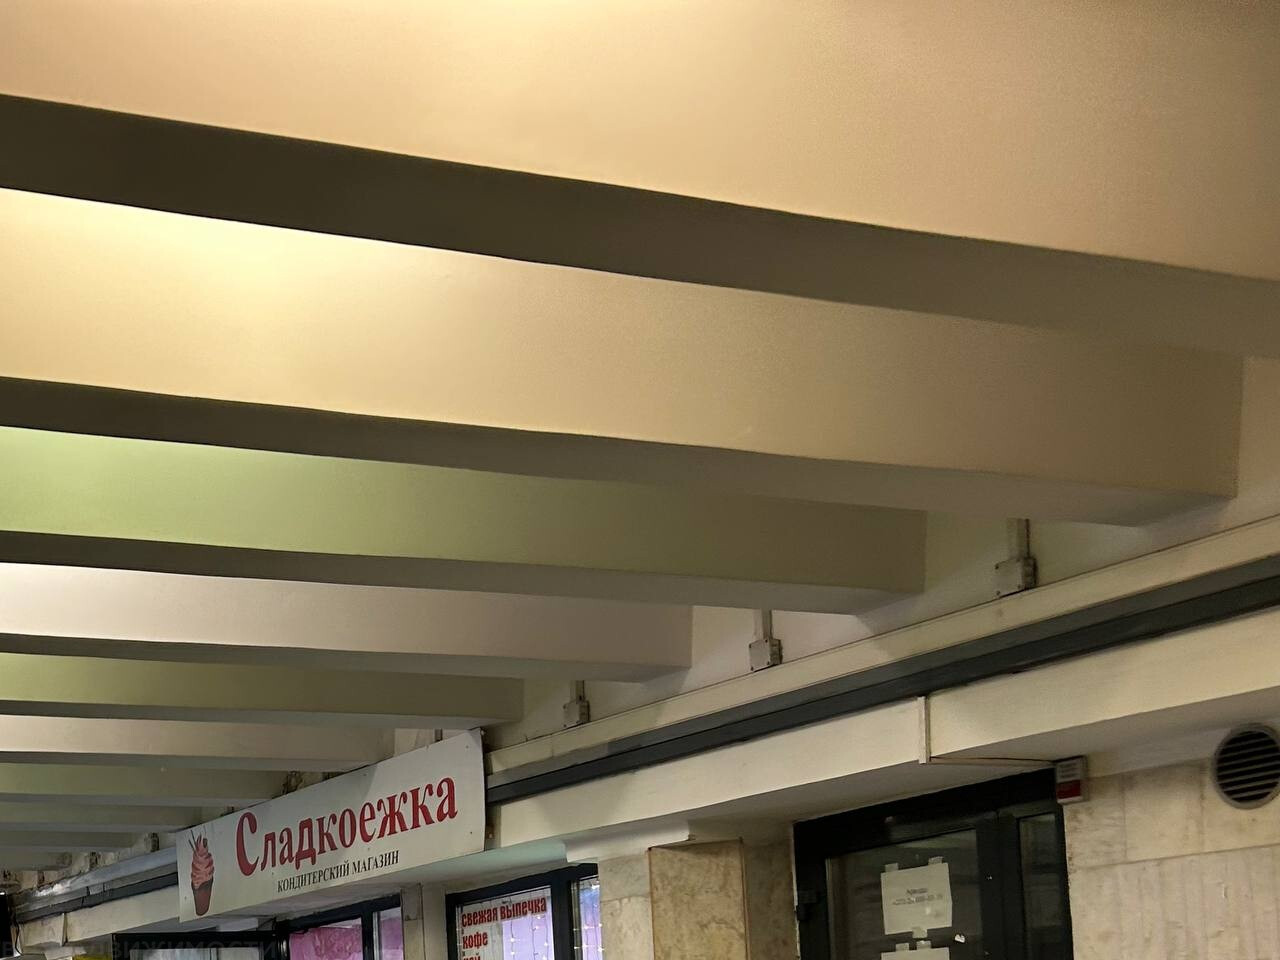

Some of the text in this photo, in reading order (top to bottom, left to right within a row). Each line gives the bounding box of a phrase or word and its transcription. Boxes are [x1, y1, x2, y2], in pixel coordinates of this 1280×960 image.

[235, 776, 459, 877] Сладкоежка
[277, 850, 400, 893] КОНДИТЕРСКИЙ МАГАЗИН
[461, 896, 547, 927] свежая выпечка
[462, 932, 488, 949] кофе
